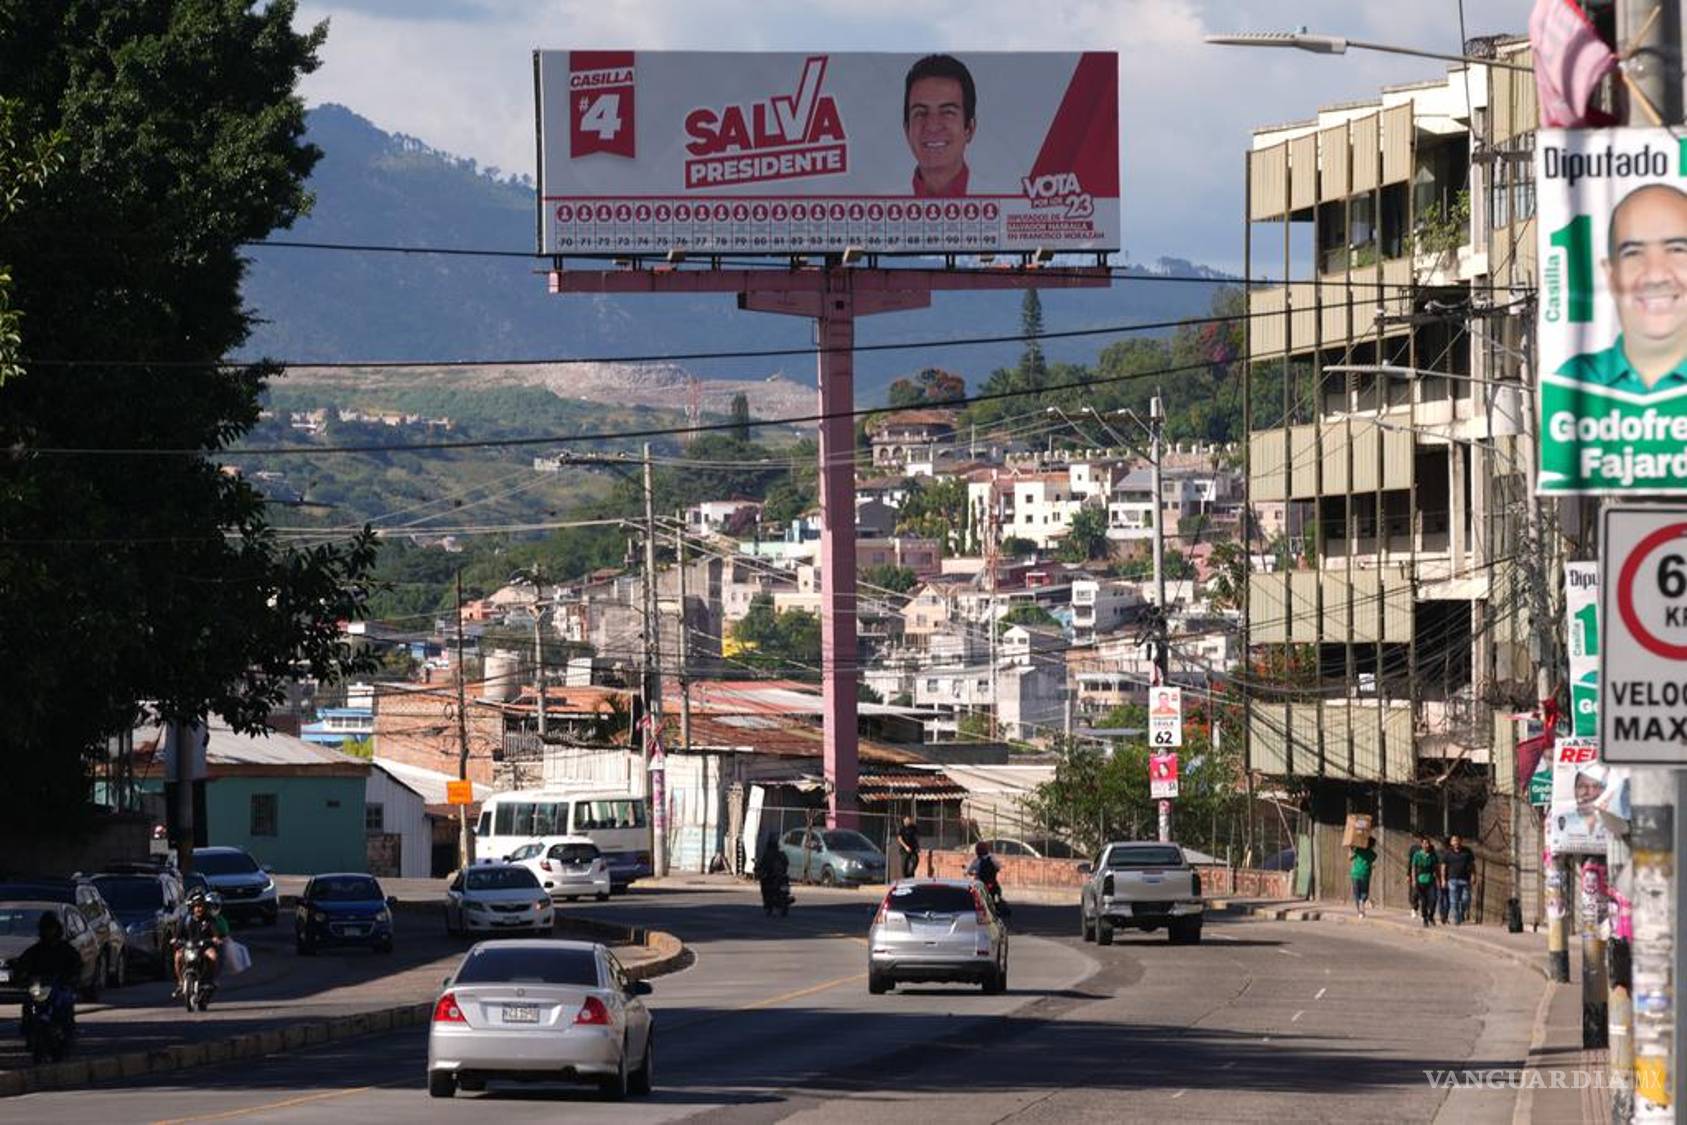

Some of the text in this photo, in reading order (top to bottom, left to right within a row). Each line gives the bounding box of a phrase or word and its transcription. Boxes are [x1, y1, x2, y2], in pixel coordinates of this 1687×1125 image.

[571, 69, 633, 88] CASILLA
[579, 94, 621, 139] #4
[685, 55, 846, 156] SALVA
[690, 150, 842, 184] PRESIDENTE
[1544, 144, 1668, 187] Diputado
[1022, 172, 1082, 199] VOTA
[1065, 193, 1094, 218] 23
[1550, 214, 1594, 323] 1
[1545, 254, 1560, 323] Casilla
[1549, 407, 1687, 442] Godofre
[1581, 445, 1687, 486] Fajard
[1665, 605, 1687, 628] K
[1611, 681, 1687, 706] VELO
[1155, 731, 1173, 744] 62
[1614, 716, 1687, 742] MAX
